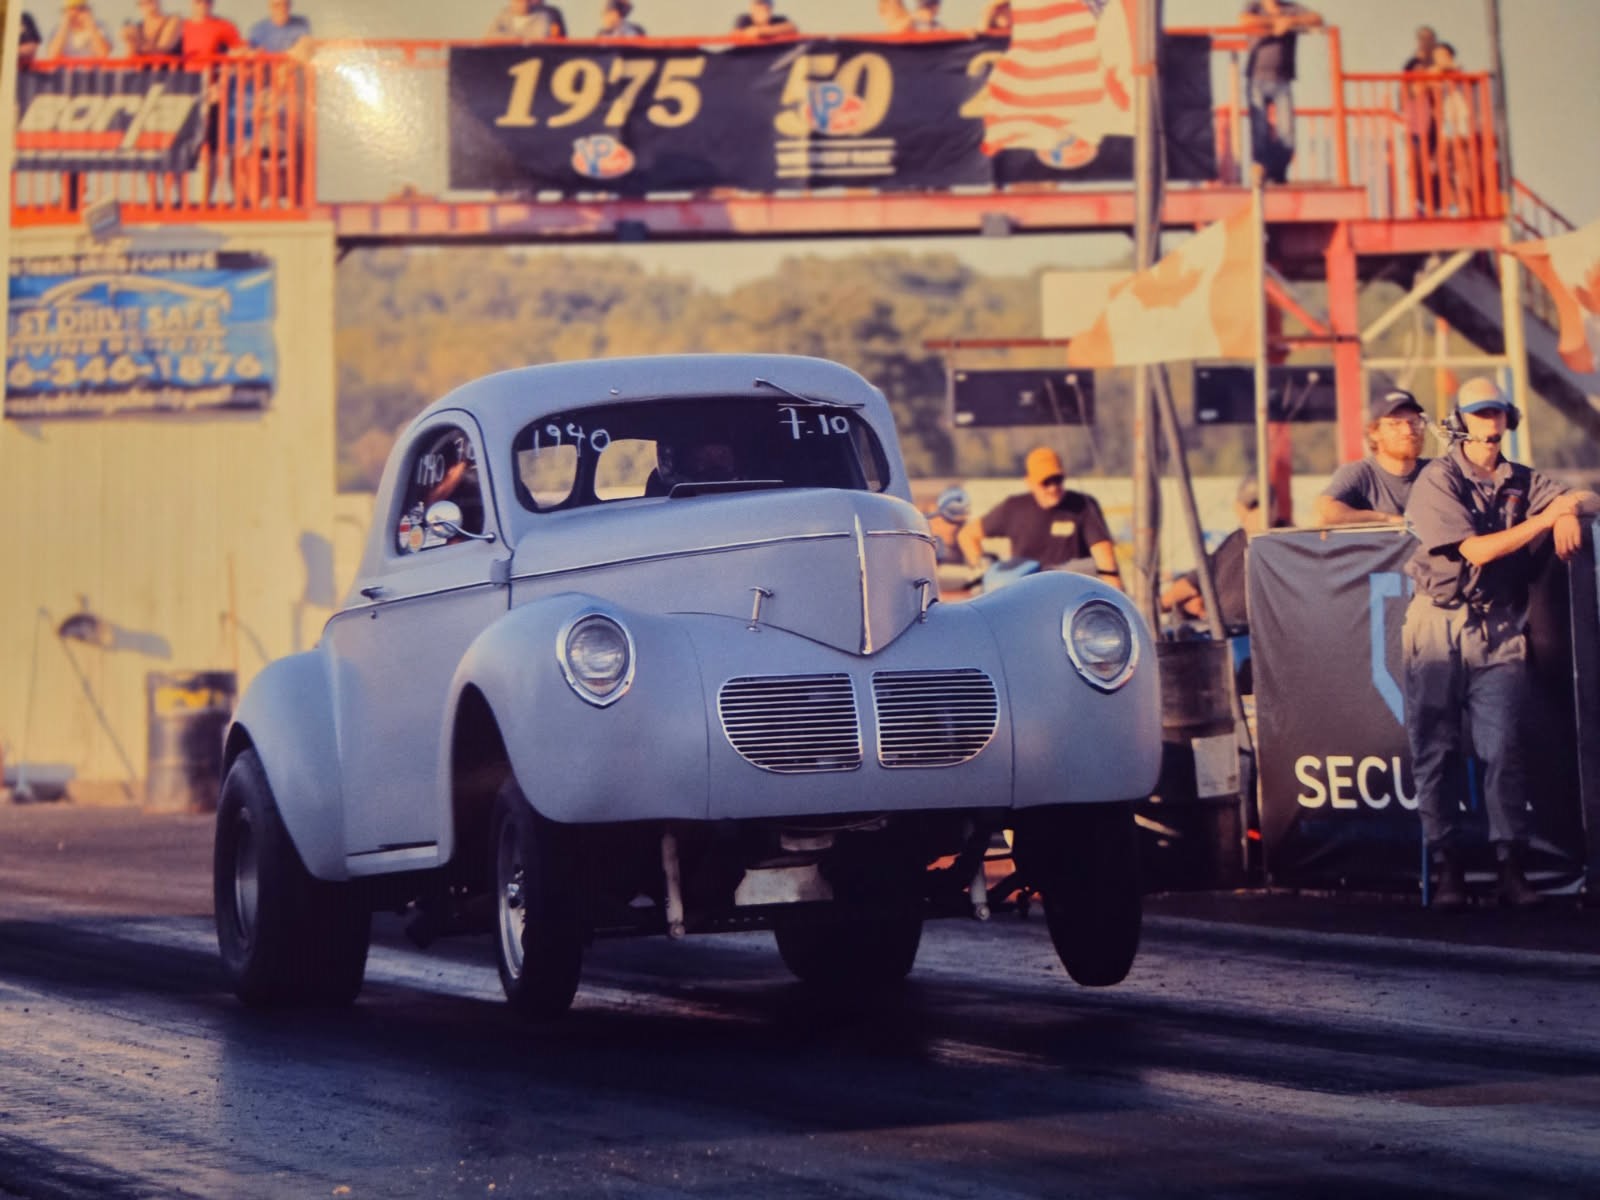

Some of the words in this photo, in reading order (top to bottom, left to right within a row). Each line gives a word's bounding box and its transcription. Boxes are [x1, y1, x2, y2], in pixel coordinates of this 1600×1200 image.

[494, 56, 707, 129] 1975
[773, 52, 894, 137] 50
[533, 422, 612, 457] 1940
